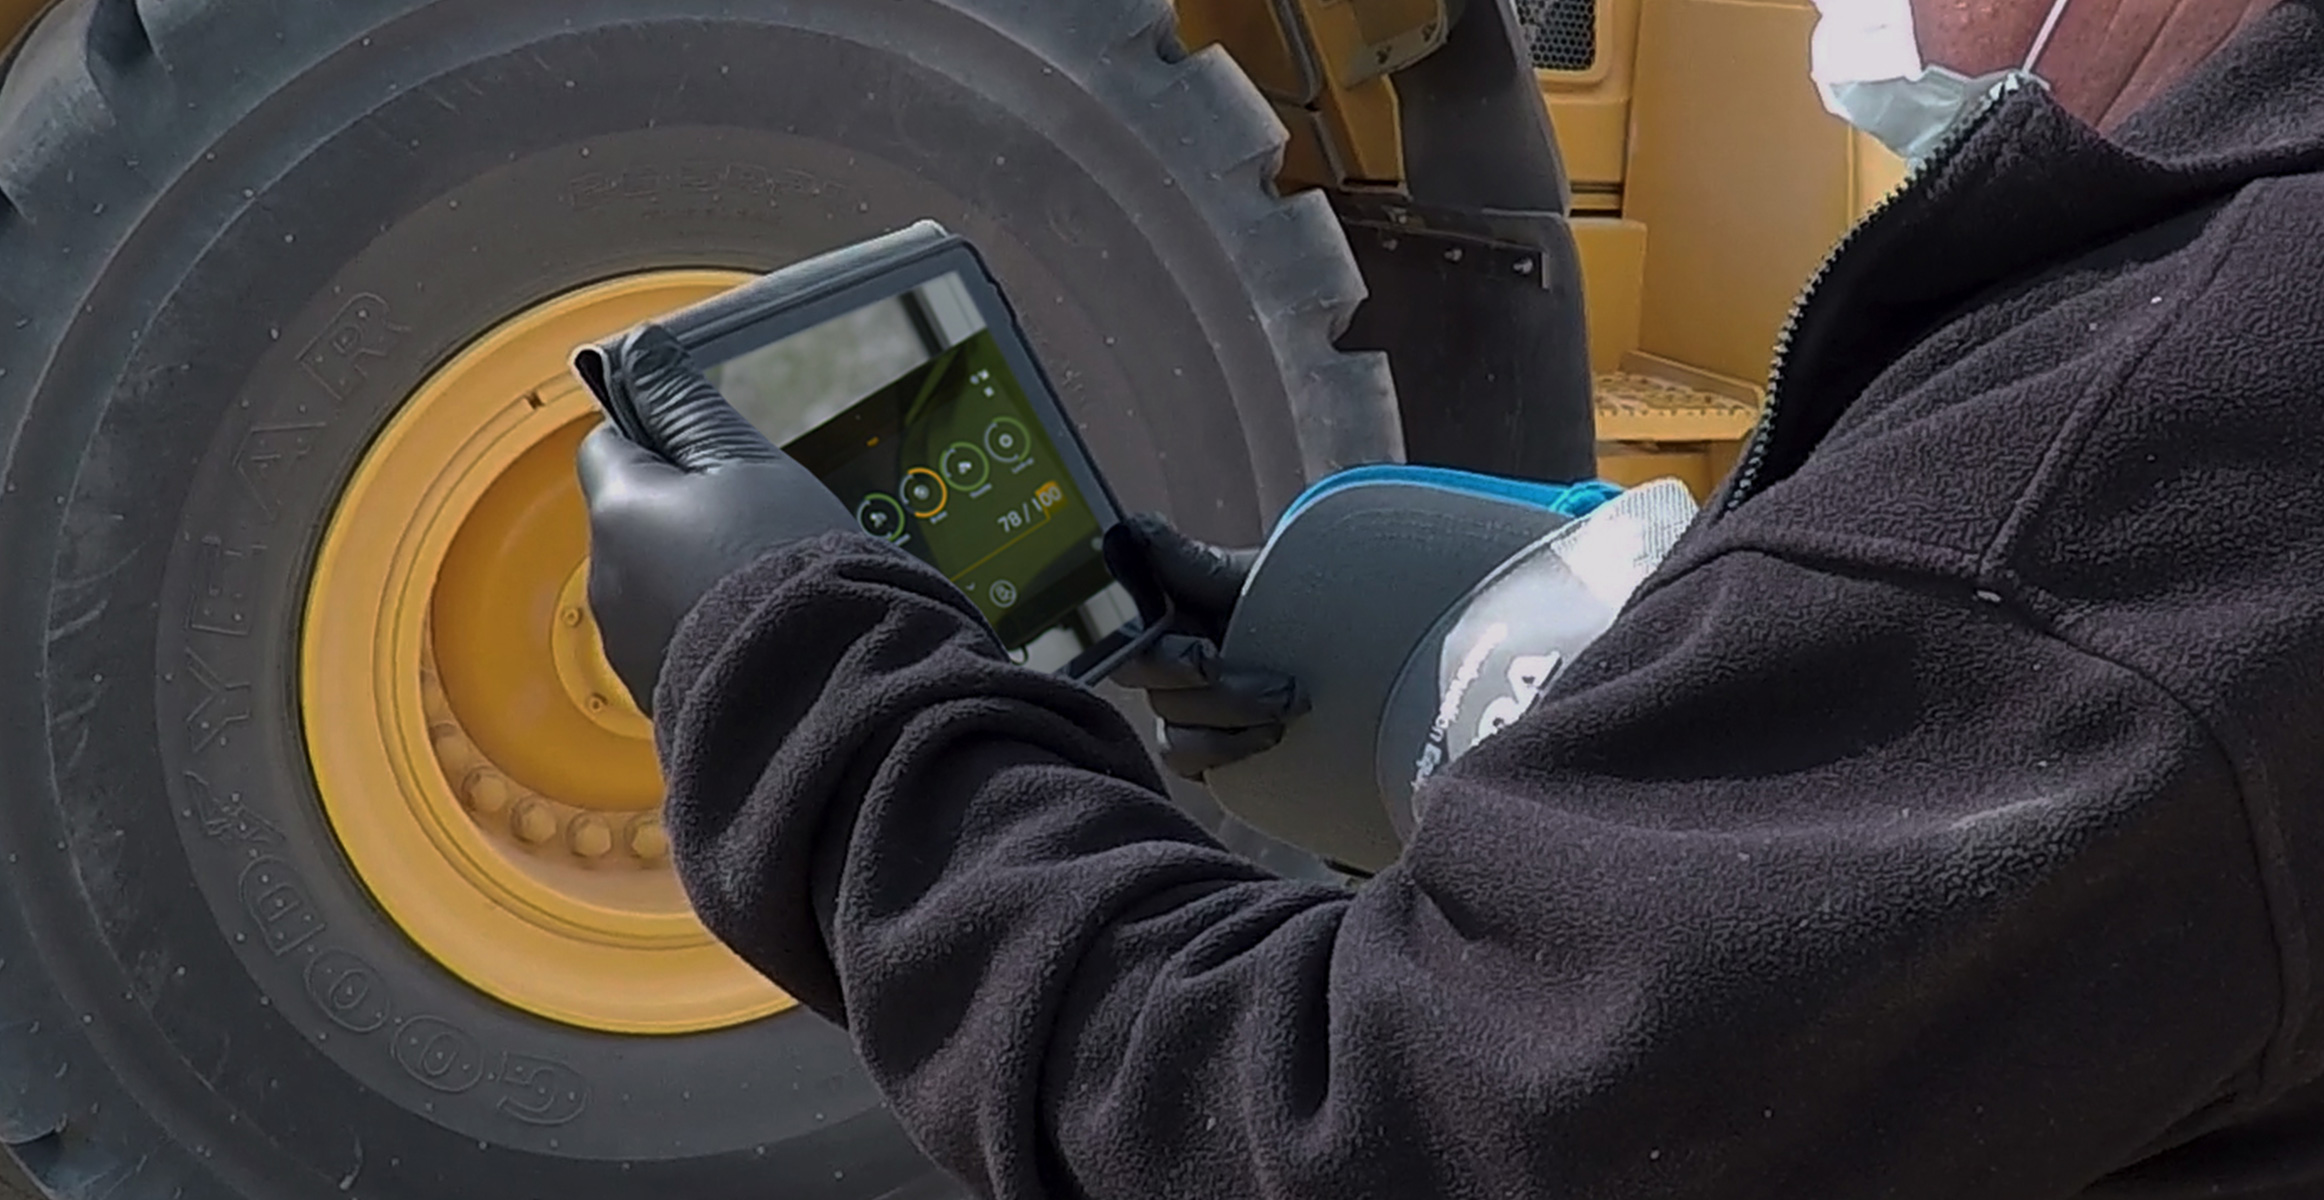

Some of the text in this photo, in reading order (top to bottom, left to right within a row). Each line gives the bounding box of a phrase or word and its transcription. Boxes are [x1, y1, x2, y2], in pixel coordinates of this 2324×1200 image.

[997, 509, 1023, 533] 78
[1032, 486, 1063, 512] 100
[1429, 622, 1508, 742] truction
